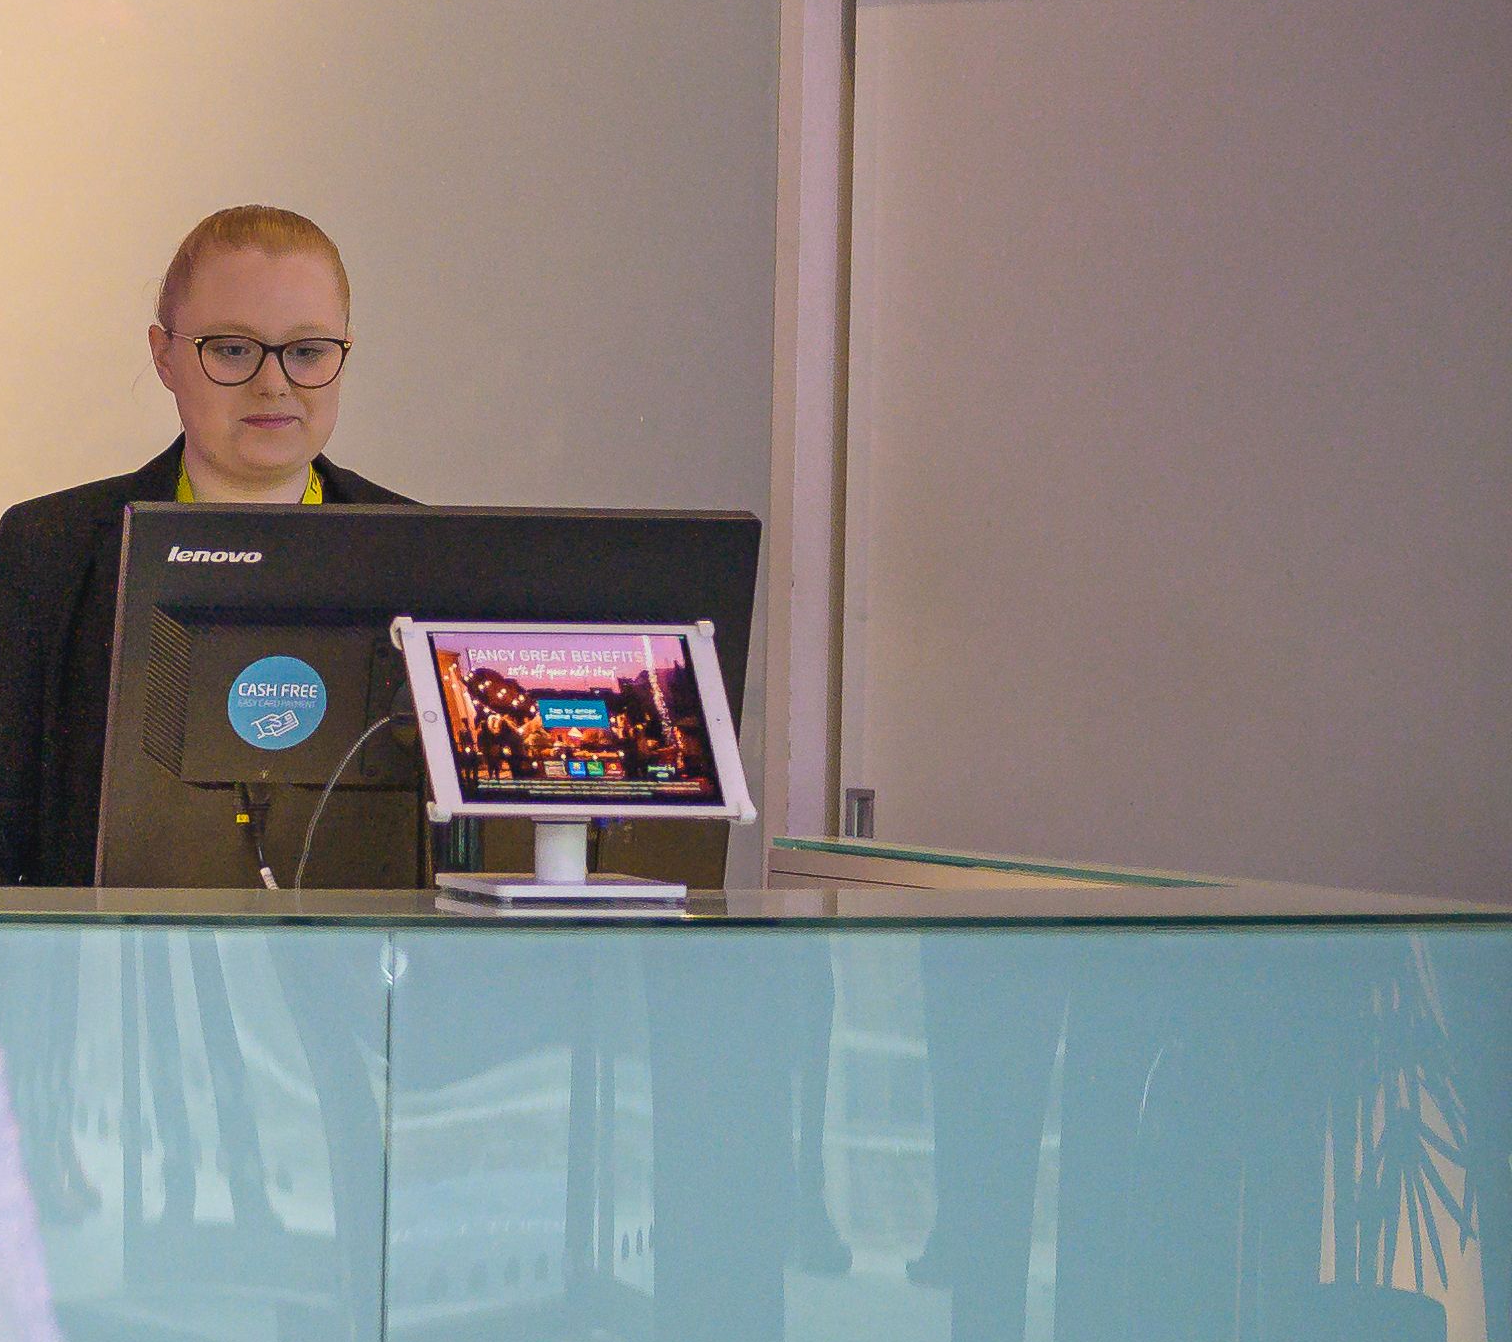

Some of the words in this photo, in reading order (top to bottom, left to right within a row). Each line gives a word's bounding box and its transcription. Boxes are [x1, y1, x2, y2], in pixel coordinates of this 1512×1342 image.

[167, 545, 263, 564] lenovo
[468, 649, 516, 663] FANCY
[519, 649, 566, 663] GREAT
[238, 682, 277, 697] CASH
[281, 683, 319, 699] FREE
